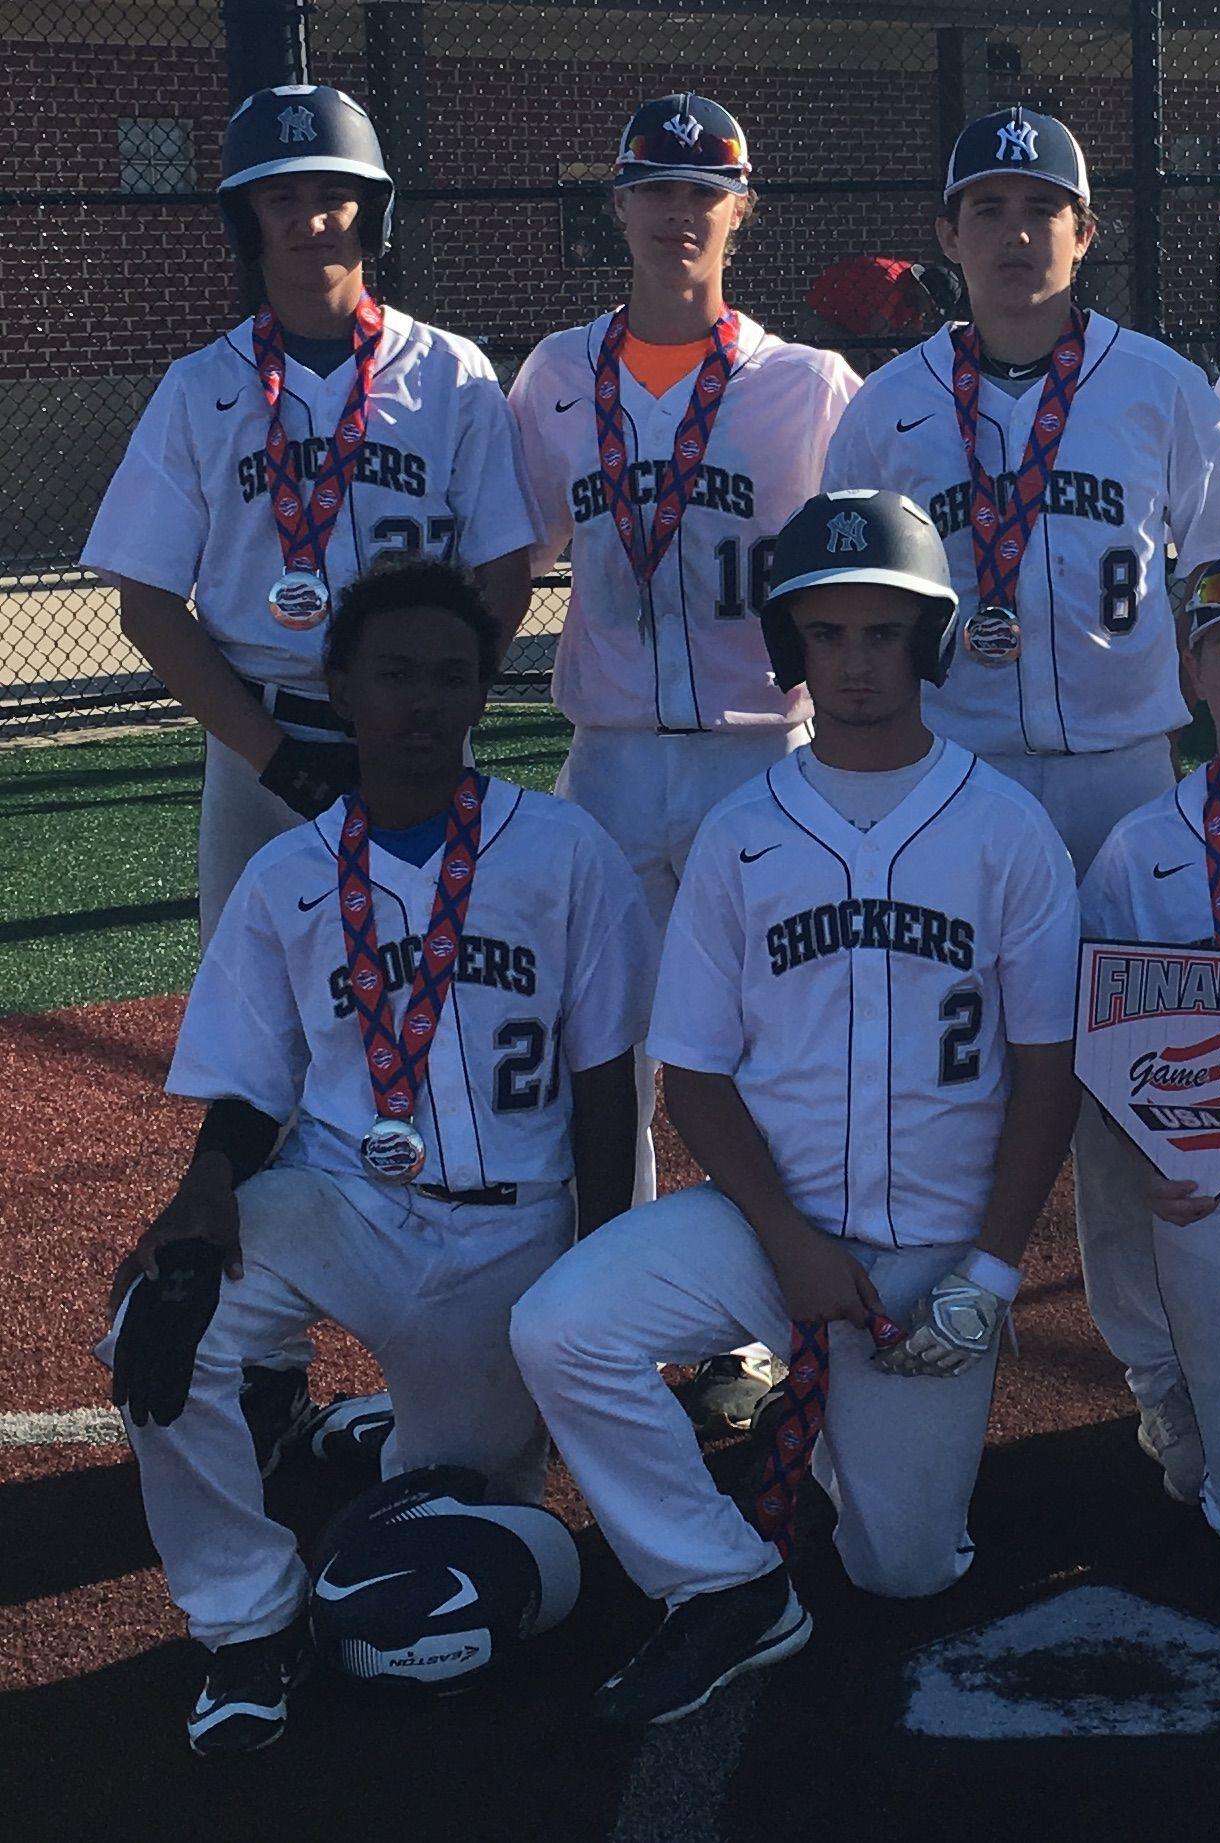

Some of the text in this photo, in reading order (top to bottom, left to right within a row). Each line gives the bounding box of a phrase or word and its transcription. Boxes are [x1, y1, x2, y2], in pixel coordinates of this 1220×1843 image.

[1101, 546, 1142, 636] 8
[766, 898, 976, 976] SHOCKERS
[937, 988, 983, 1088] 2
[1129, 1051, 1211, 1097] Game
